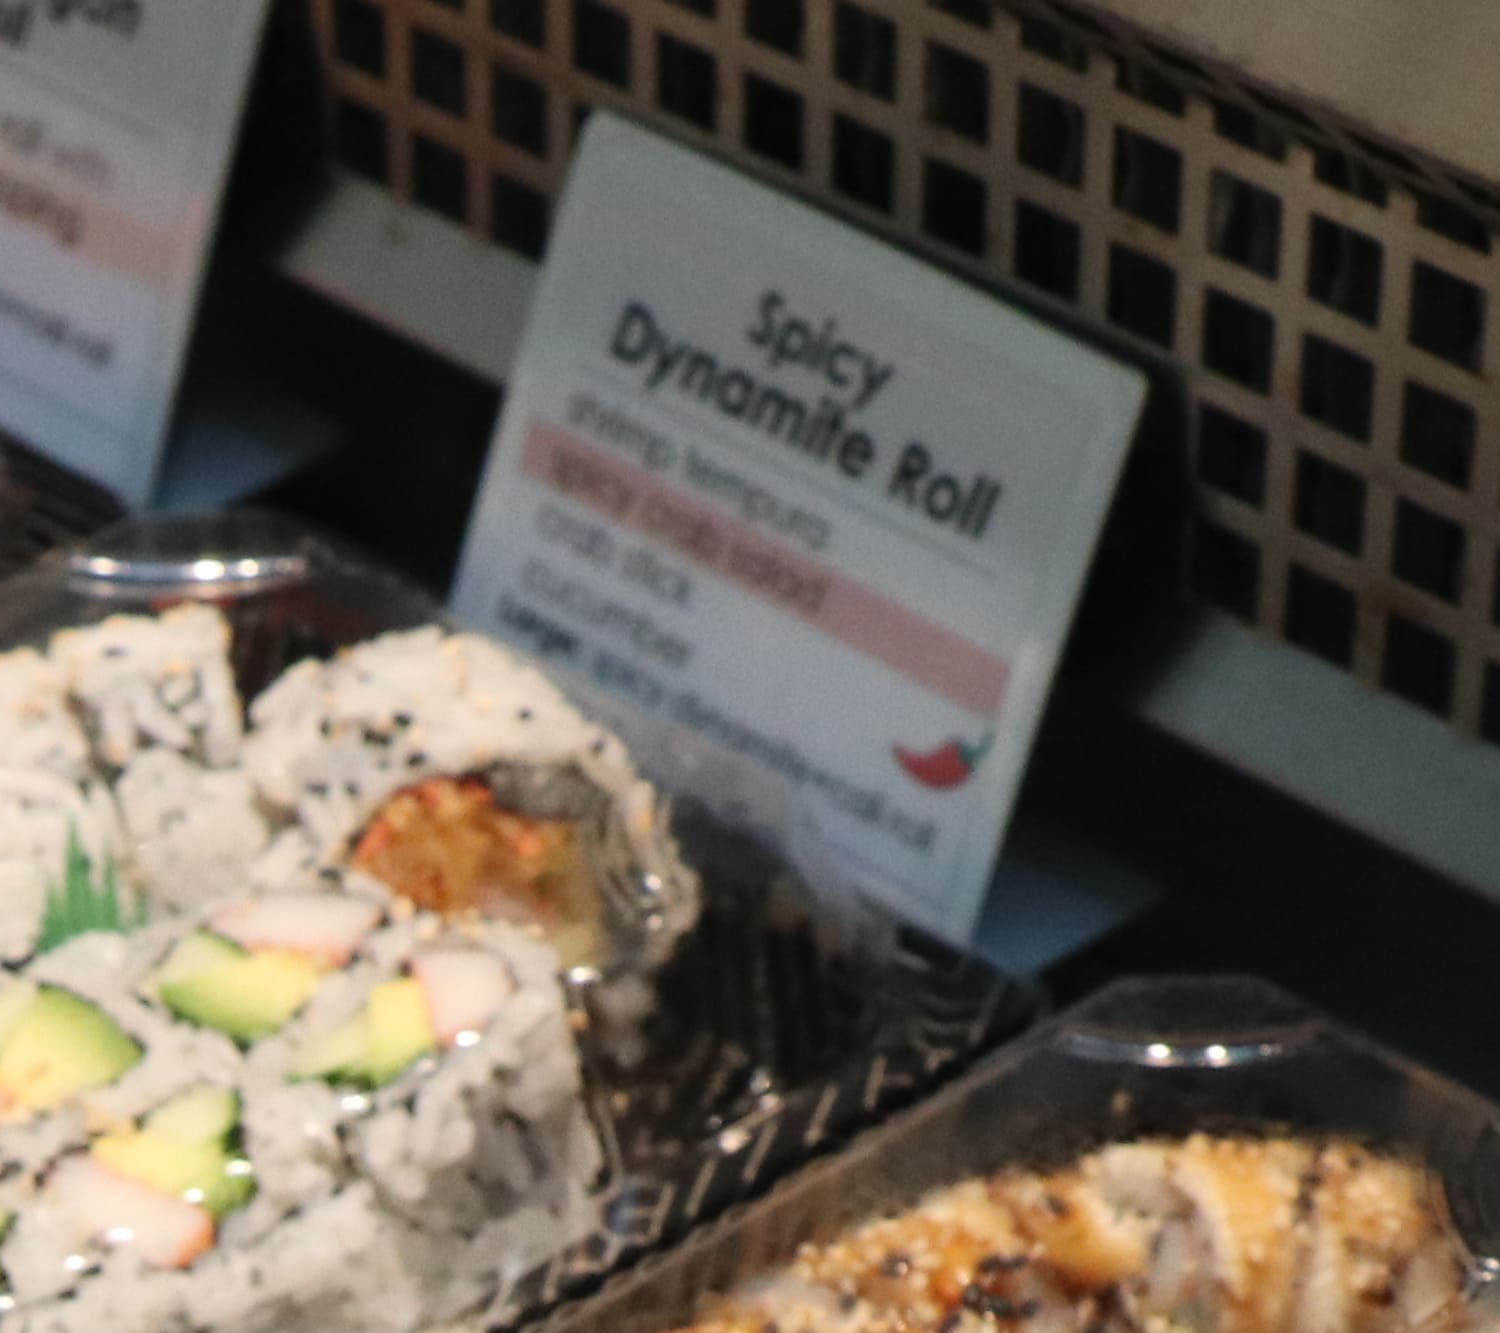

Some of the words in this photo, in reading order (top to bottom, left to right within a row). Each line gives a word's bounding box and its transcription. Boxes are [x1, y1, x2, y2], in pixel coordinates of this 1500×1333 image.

[610, 298, 876, 481] Dynamite
[887, 440, 1001, 542] Roll
[745, 287, 896, 408] Spicy
